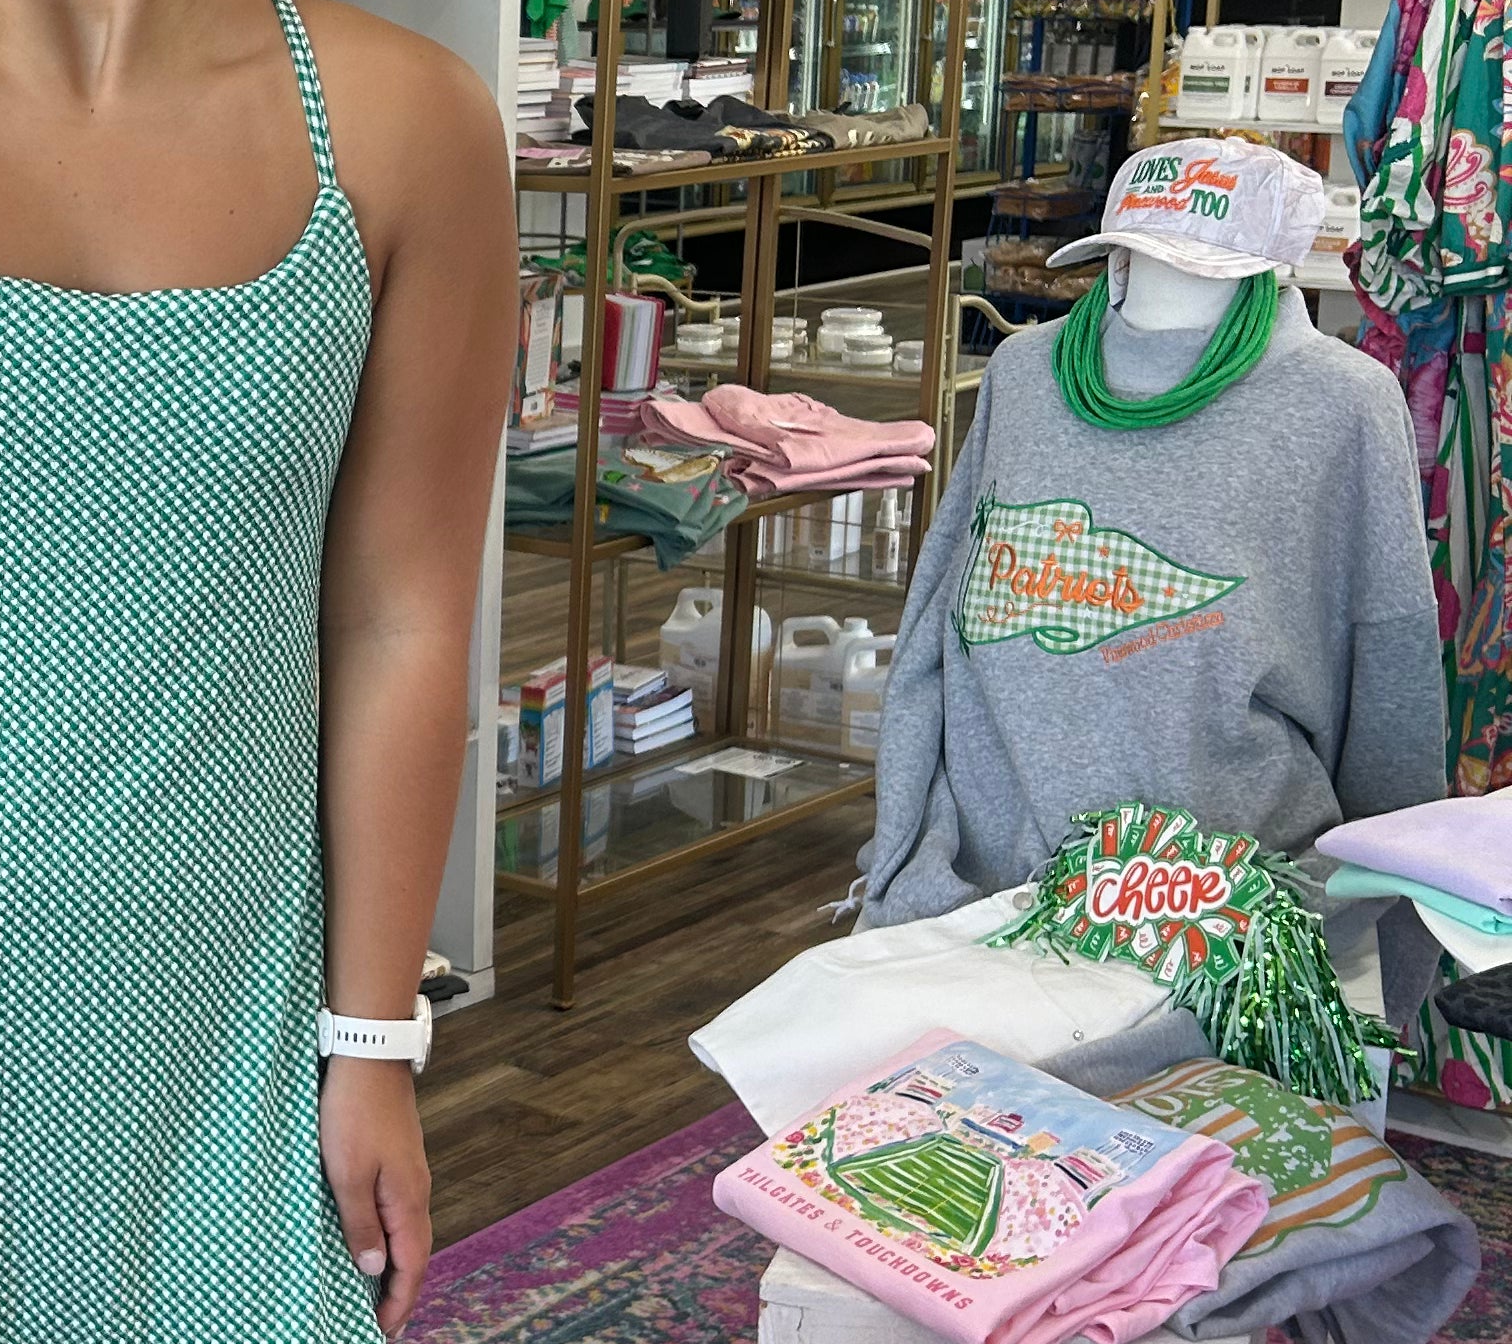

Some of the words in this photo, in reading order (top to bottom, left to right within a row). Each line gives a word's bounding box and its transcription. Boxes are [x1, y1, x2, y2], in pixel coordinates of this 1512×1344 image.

[1129, 156, 1182, 185] LOVES
[1143, 184, 1165, 194] AND
[1189, 189, 1229, 220] TOO
[988, 542, 1145, 614] Patriots
[737, 1167, 825, 1221] TAILGATES
[824, 1218, 842, 1233] &
[844, 1229, 974, 1310] TOUCHDOWNS
